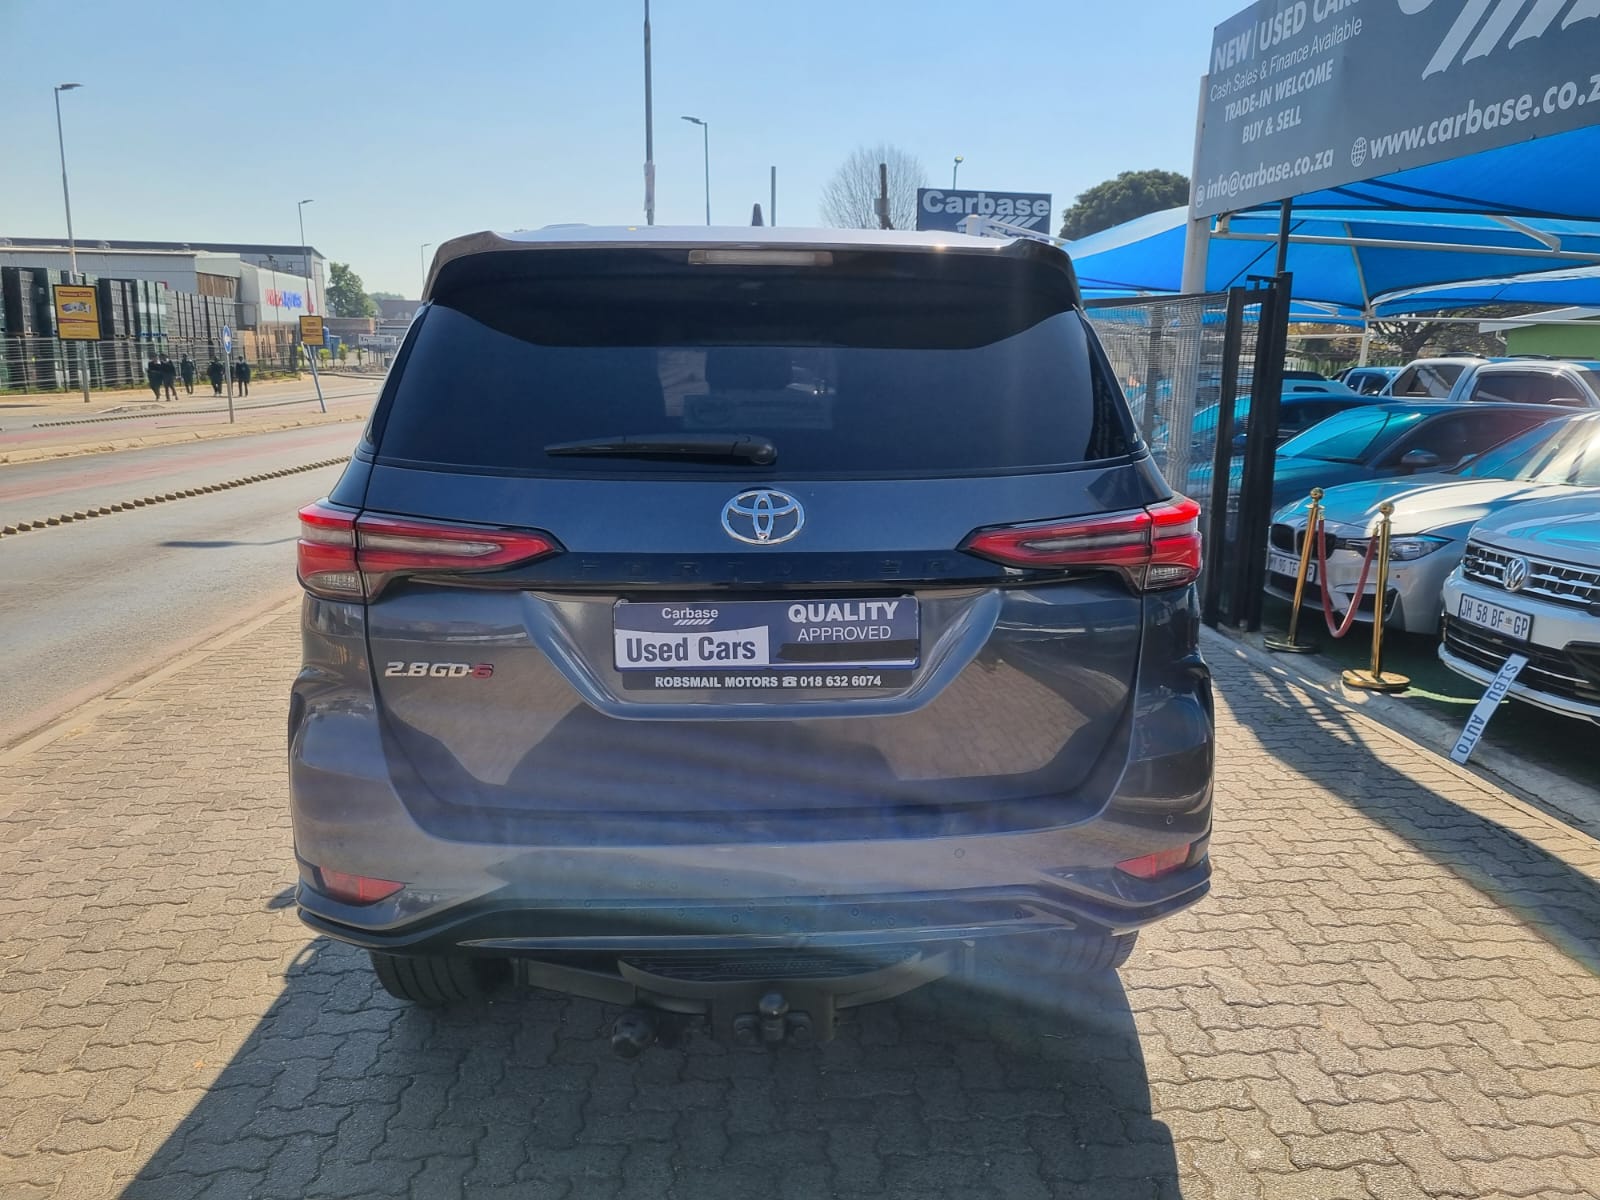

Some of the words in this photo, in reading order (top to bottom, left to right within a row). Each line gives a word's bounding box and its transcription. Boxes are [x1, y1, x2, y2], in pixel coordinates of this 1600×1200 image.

[1214, 28, 1251, 74] NEW
[1259, 1, 1307, 51] USED
[1210, 81, 1232, 102] Cash
[1233, 68, 1258, 92] Sales
[1259, 60, 1267, 80] &
[1269, 46, 1309, 75] Finance
[1310, 15, 1362, 57] Available
[1224, 86, 1272, 123] TRADE-IN
[1275, 58, 1334, 102] WELCOME
[1242, 120, 1265, 144] BUY
[1265, 119, 1273, 136] &
[1276, 105, 1302, 131] SELL
[1206, 149, 1334, 199] info@carbase.co.za
[922, 190, 1050, 216] Carbase
[661, 607, 719, 619] Carbase
[788, 601, 899, 623] QUALITY
[1461, 599, 1473, 618] JH
[1476, 602, 1488, 623] 58
[1490, 608, 1505, 628] BF
[1513, 615, 1529, 637] GP
[626, 637, 689, 662] Used
[698, 636, 756, 661] Cars
[797, 625, 892, 641] APPROVED
[655, 676, 721, 688] ROBSMAIL
[725, 676, 778, 688] MOTORS
[800, 676, 823, 687] 018
[826, 676, 848, 687] 632
[851, 675, 882, 687] 6074
[1485, 663, 1518, 702] SIBU
[1456, 714, 1485, 754] AUTO
